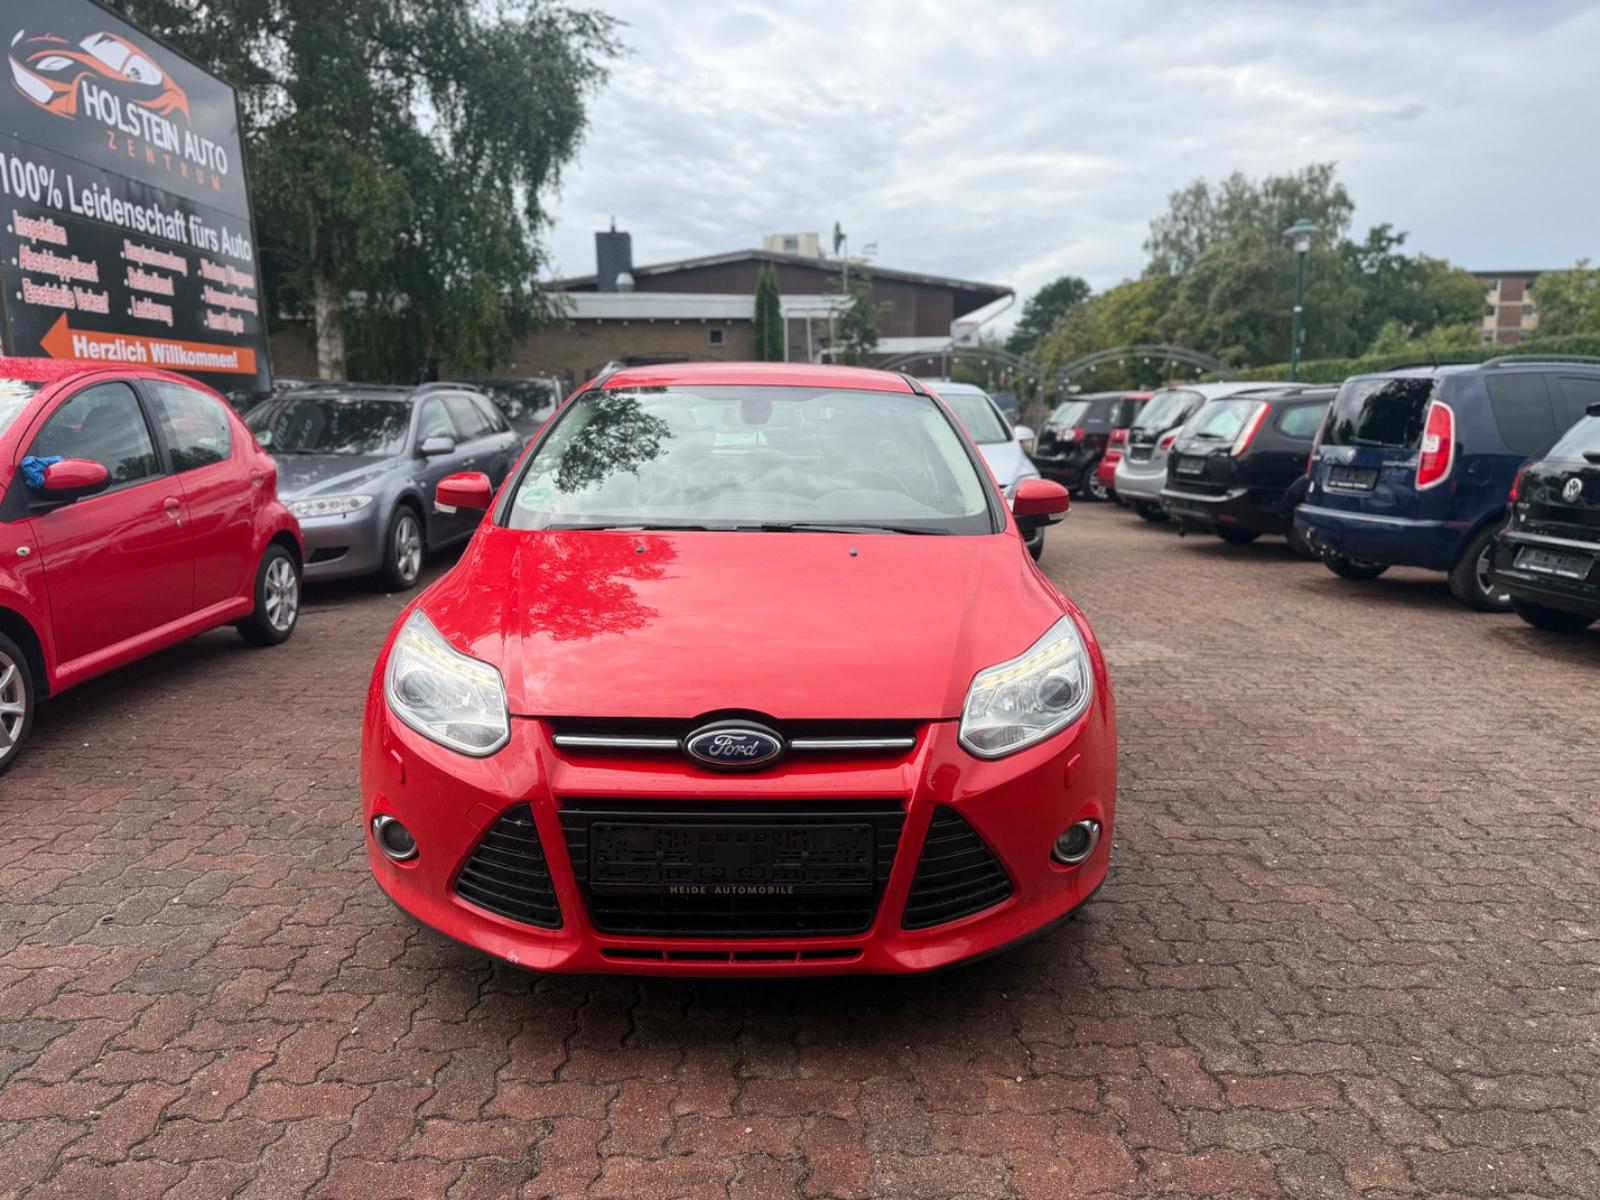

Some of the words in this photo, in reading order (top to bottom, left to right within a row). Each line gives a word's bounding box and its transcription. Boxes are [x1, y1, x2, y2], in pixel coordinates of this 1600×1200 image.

[82, 80, 180, 154] HOLSTEIN
[184, 131, 228, 175] AUTO
[107, 131, 221, 190] ZENTRUM
[0, 152, 63, 210] 100%
[66, 174, 188, 244] Leidenschaft
[189, 214, 219, 252] fürs
[221, 226, 252, 261] Auto
[72, 335, 147, 362] Herzlich
[150, 342, 239, 368] Willkommen!
[708, 734, 760, 756] Ford
[669, 886, 706, 895] HEIDE
[714, 886, 794, 895] AUTOMOBILE
